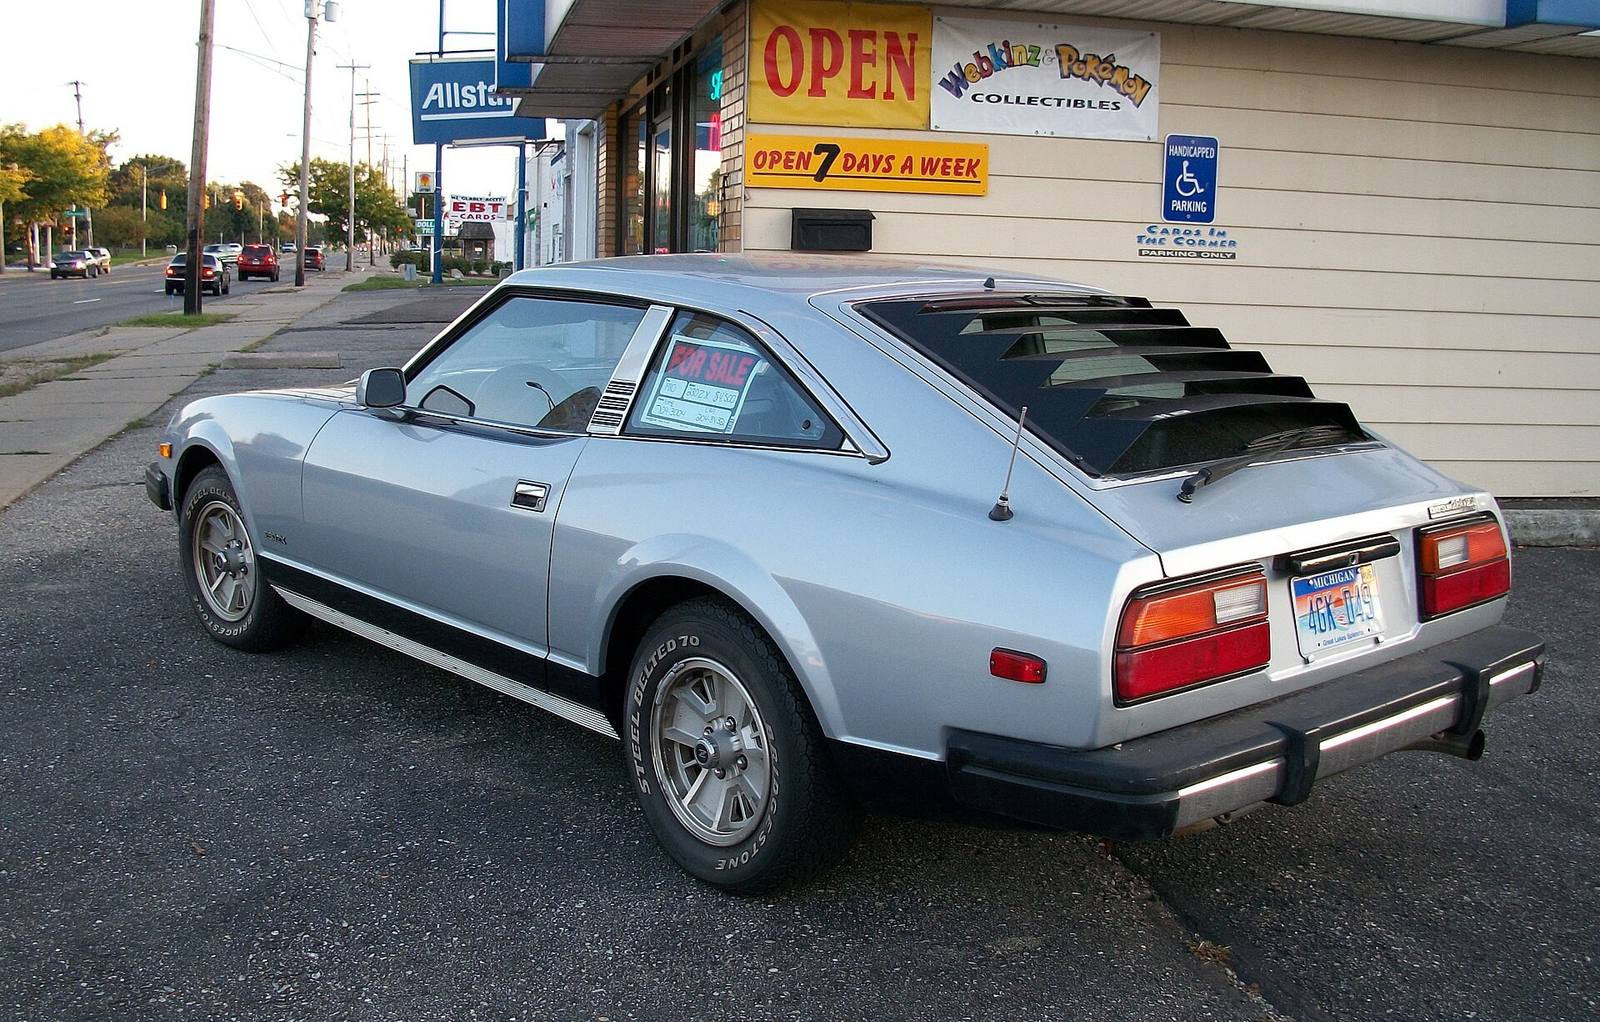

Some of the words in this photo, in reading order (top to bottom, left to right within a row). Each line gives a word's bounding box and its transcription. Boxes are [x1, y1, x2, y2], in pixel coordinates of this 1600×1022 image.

[764, 25, 918, 101] OPEN
[938, 40, 1041, 99] Webkinz
[1042, 48, 1055, 65] &
[422, 81, 512, 109] Allsta
[971, 93, 1121, 111] COLLECTIBLES
[753, 150, 812, 171] OPEN
[813, 143, 841, 182] 7
[842, 153, 896, 174] DAYS
[900, 155, 914, 174] A
[920, 156, 981, 178] WEEK
[1168, 145, 1215, 159] HANDICAPPED
[452, 202, 503, 213] EBT
[1171, 200, 1207, 213] PARKING
[1201, 251, 1234, 259] ONLY
[666, 344, 707, 378] FOR
[704, 351, 754, 387] SALE
[186, 487, 210, 521] STEEL
[1313, 570, 1355, 589] MICHIGAN
[1308, 590, 1336, 635] 4GK
[678, 635, 700, 647] 70
[634, 638, 677, 708] BELTED
[630, 711, 651, 795] STEEL
[715, 724, 779, 870] BRIDGESTONE
